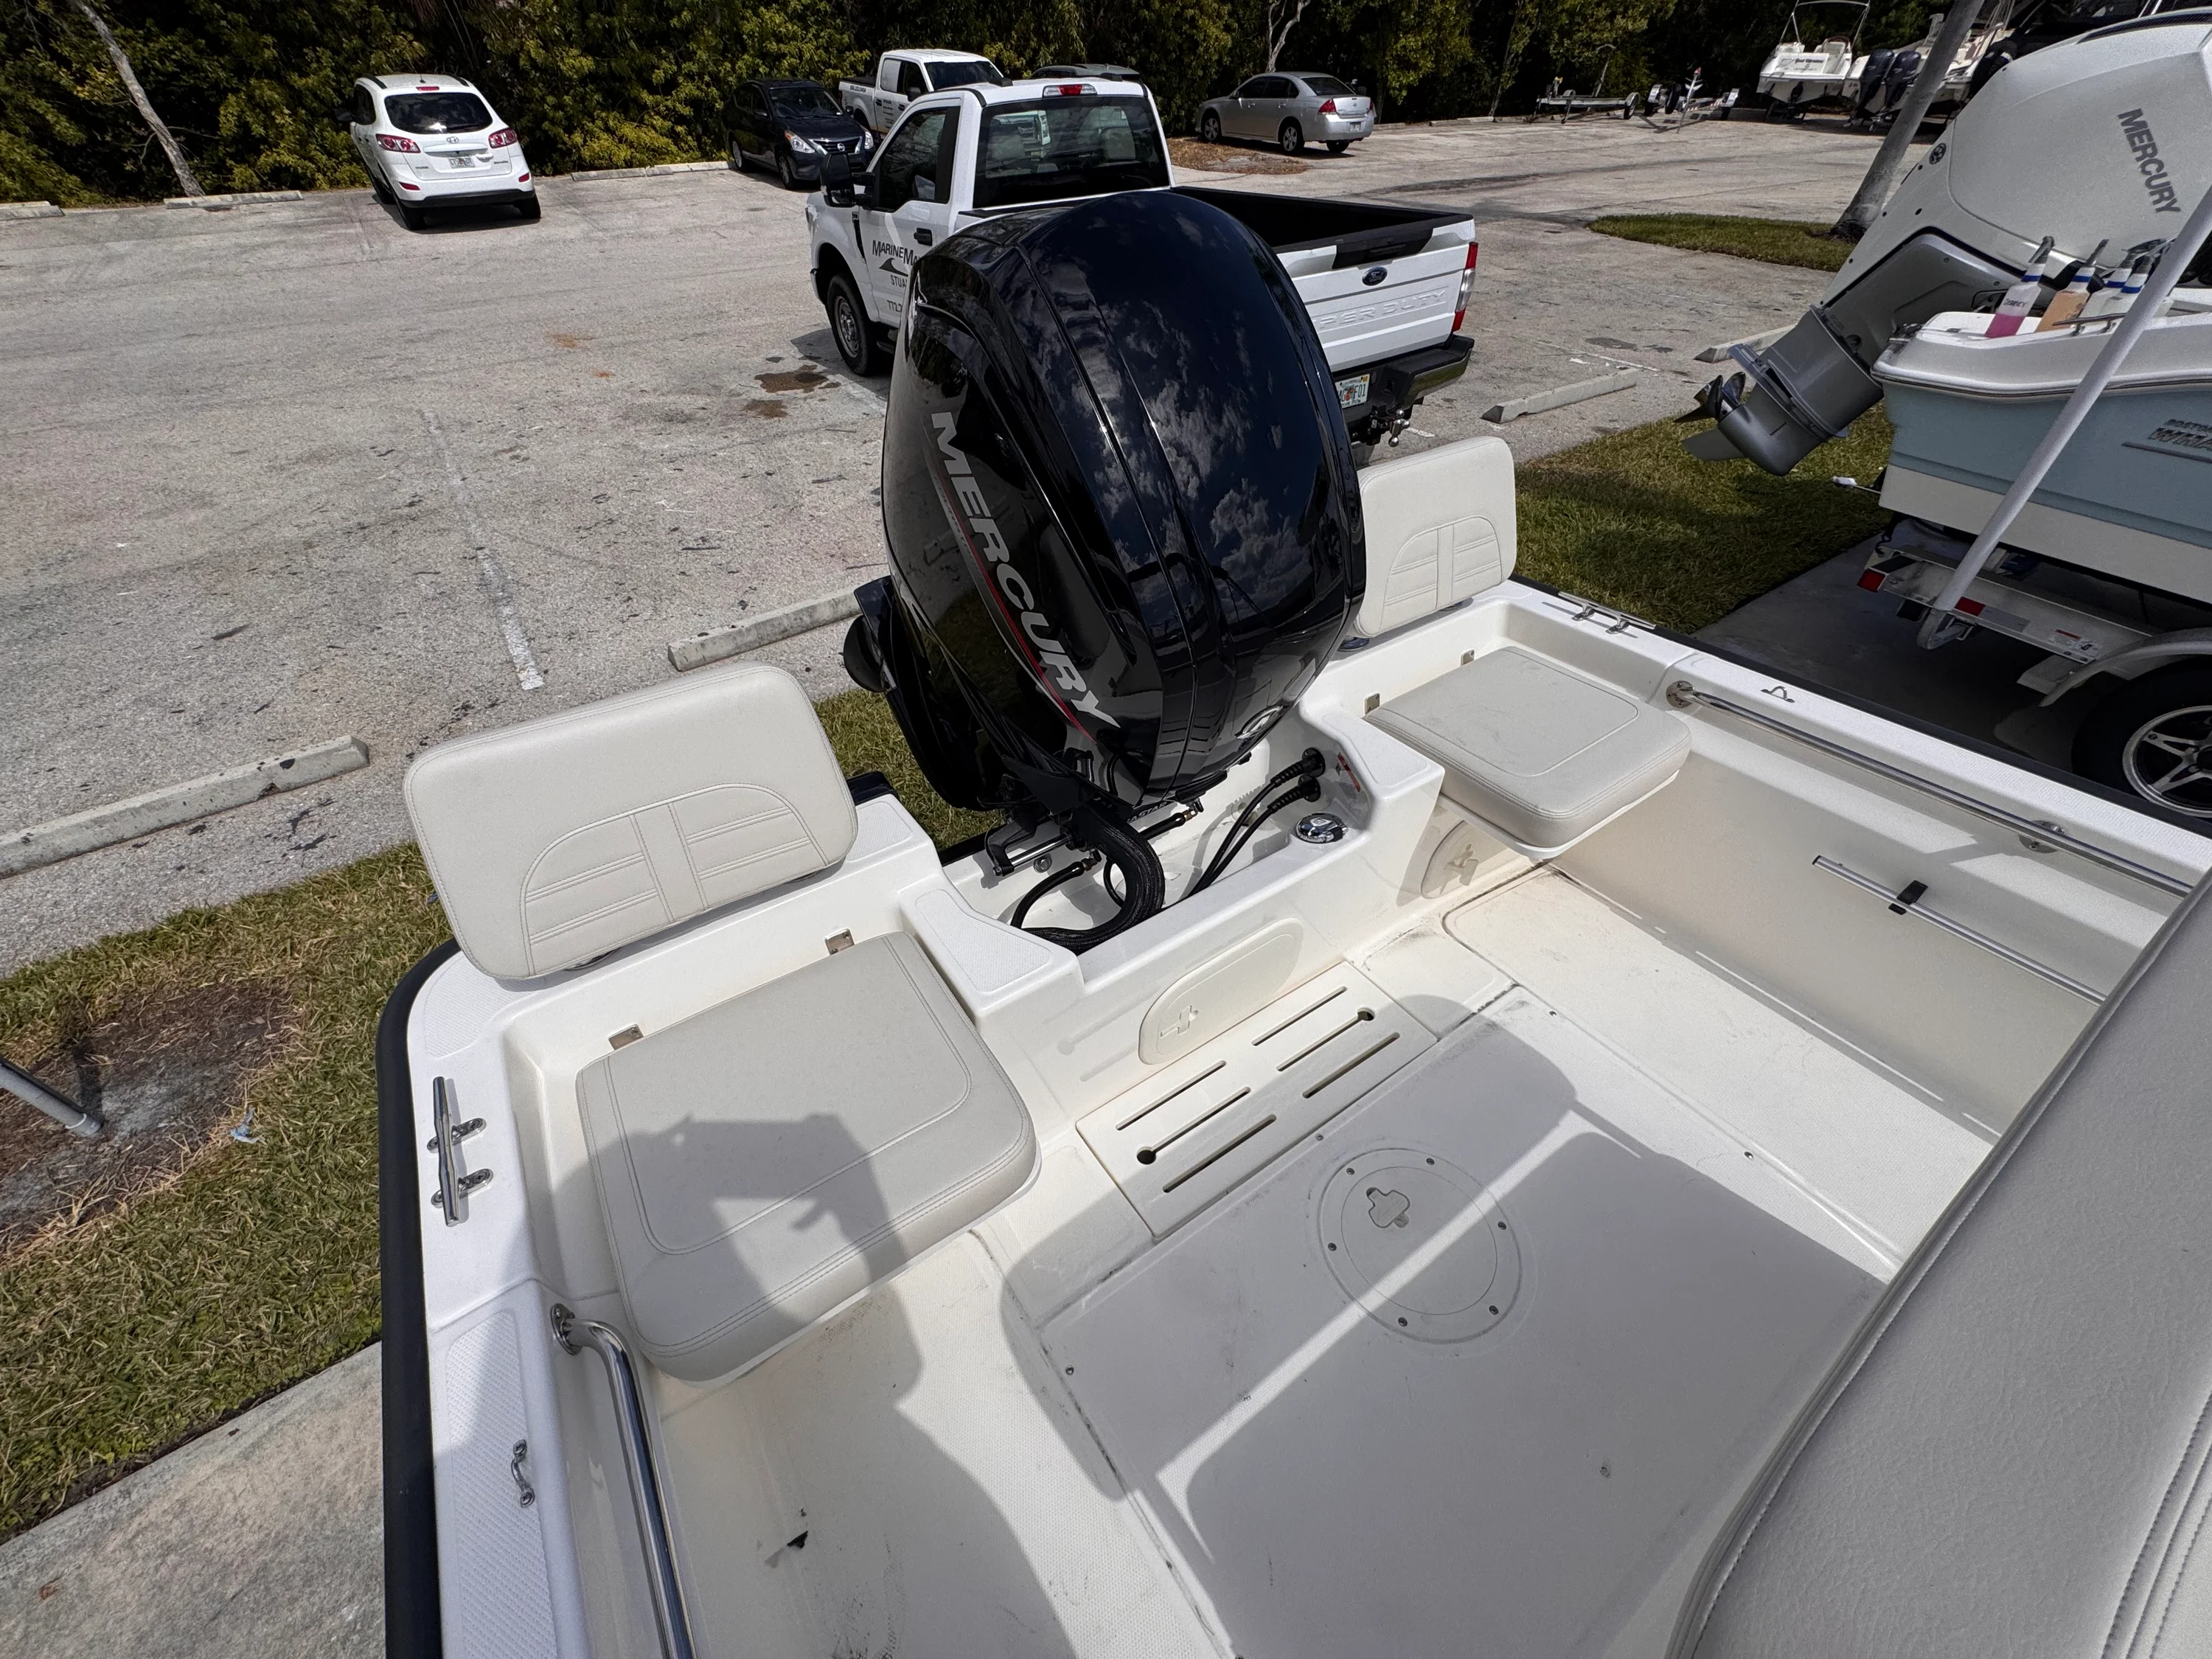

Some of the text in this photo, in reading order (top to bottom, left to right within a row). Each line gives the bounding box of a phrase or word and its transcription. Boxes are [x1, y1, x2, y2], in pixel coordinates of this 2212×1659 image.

[2117, 108, 2181, 212] MERCURY
[872, 240, 920, 265] MARINEMA
[890, 274, 908, 288] STUA
[930, 411, 1121, 728] MERCURY
